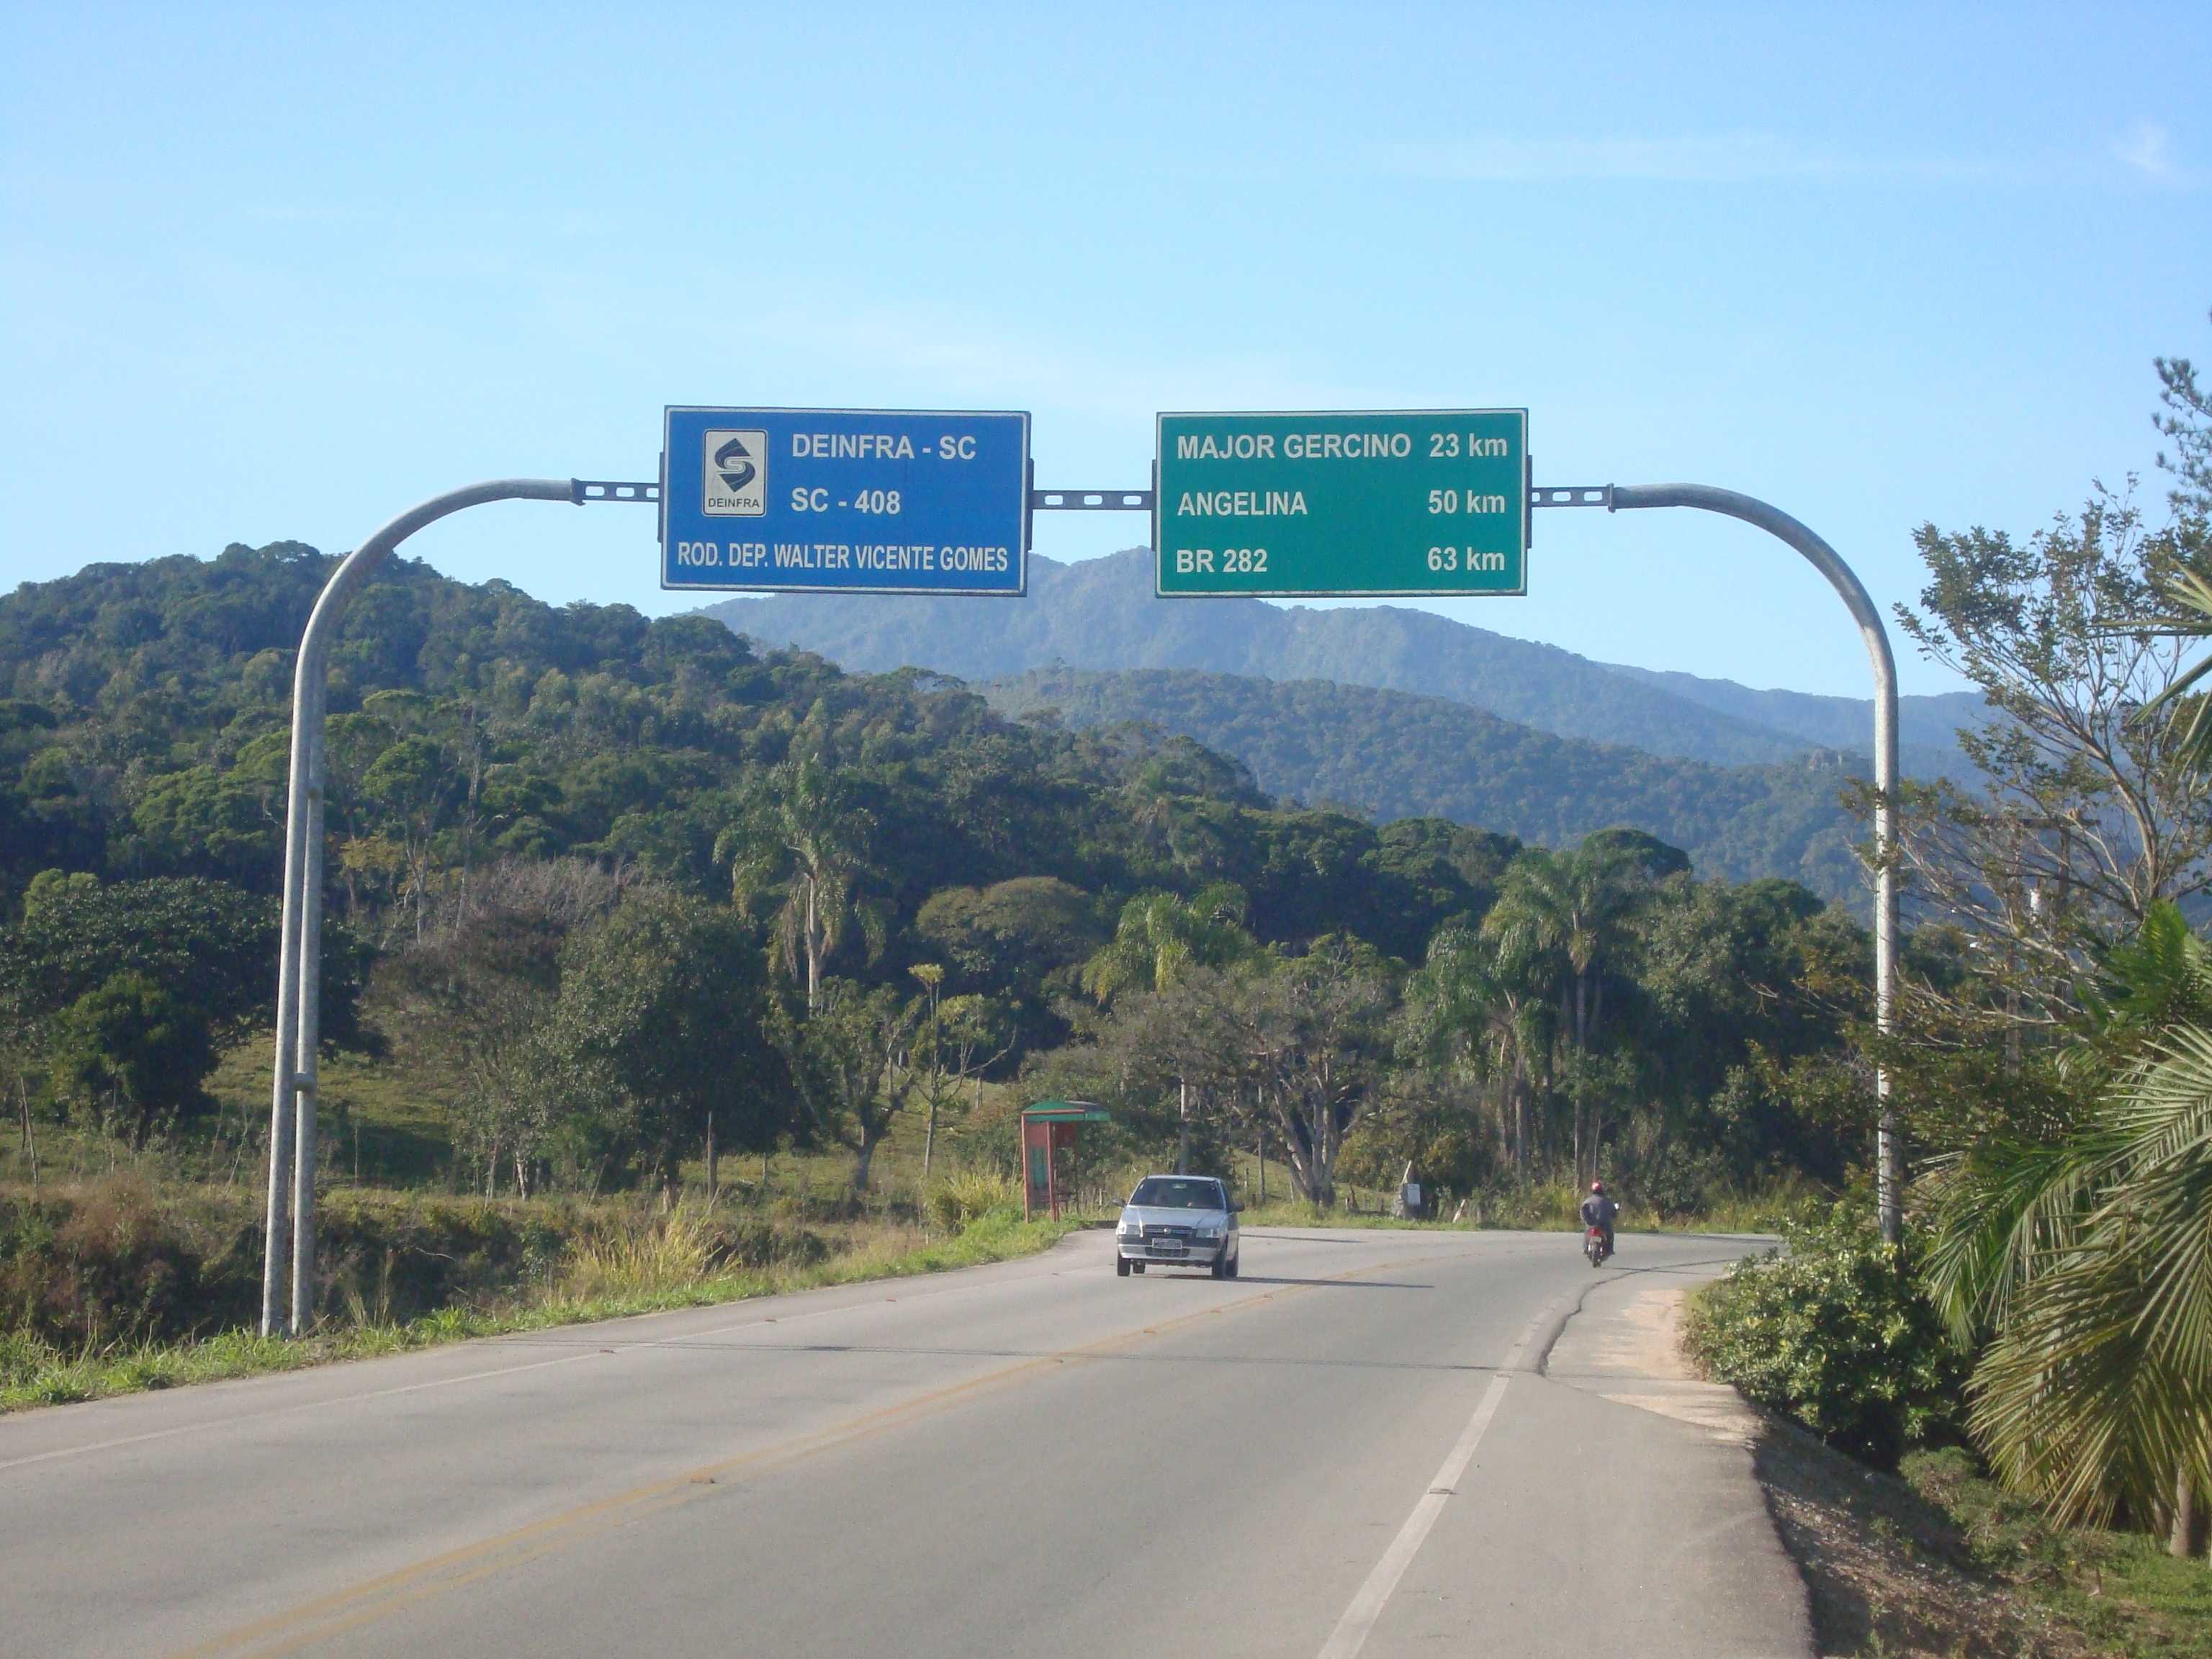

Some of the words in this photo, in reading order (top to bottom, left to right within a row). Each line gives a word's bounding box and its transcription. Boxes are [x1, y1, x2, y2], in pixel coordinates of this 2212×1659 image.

[791, 433, 914, 459] DEINFRA
[939, 436, 976, 459] SC
[1177, 434, 1274, 459] MAJOR
[1284, 433, 1411, 458] GERCINO
[1429, 433, 1460, 458] 23
[1469, 433, 1507, 457] km
[708, 497, 760, 508] DEINFRA
[791, 487, 829, 512] SC
[854, 490, 901, 514] 408
[1177, 491, 1308, 516] ANGELINA
[1428, 490, 1457, 514] 50
[1467, 490, 1506, 514] km
[678, 541, 723, 566] ROD.
[729, 543, 768, 567] DEP.
[774, 544, 850, 569] WALTER
[855, 546, 934, 571] VICENTE
[940, 547, 1008, 572] GOMES
[1176, 549, 1215, 574] BR
[1223, 548, 1268, 573] 282
[1427, 547, 1457, 572] 63
[1466, 547, 1506, 572] km
